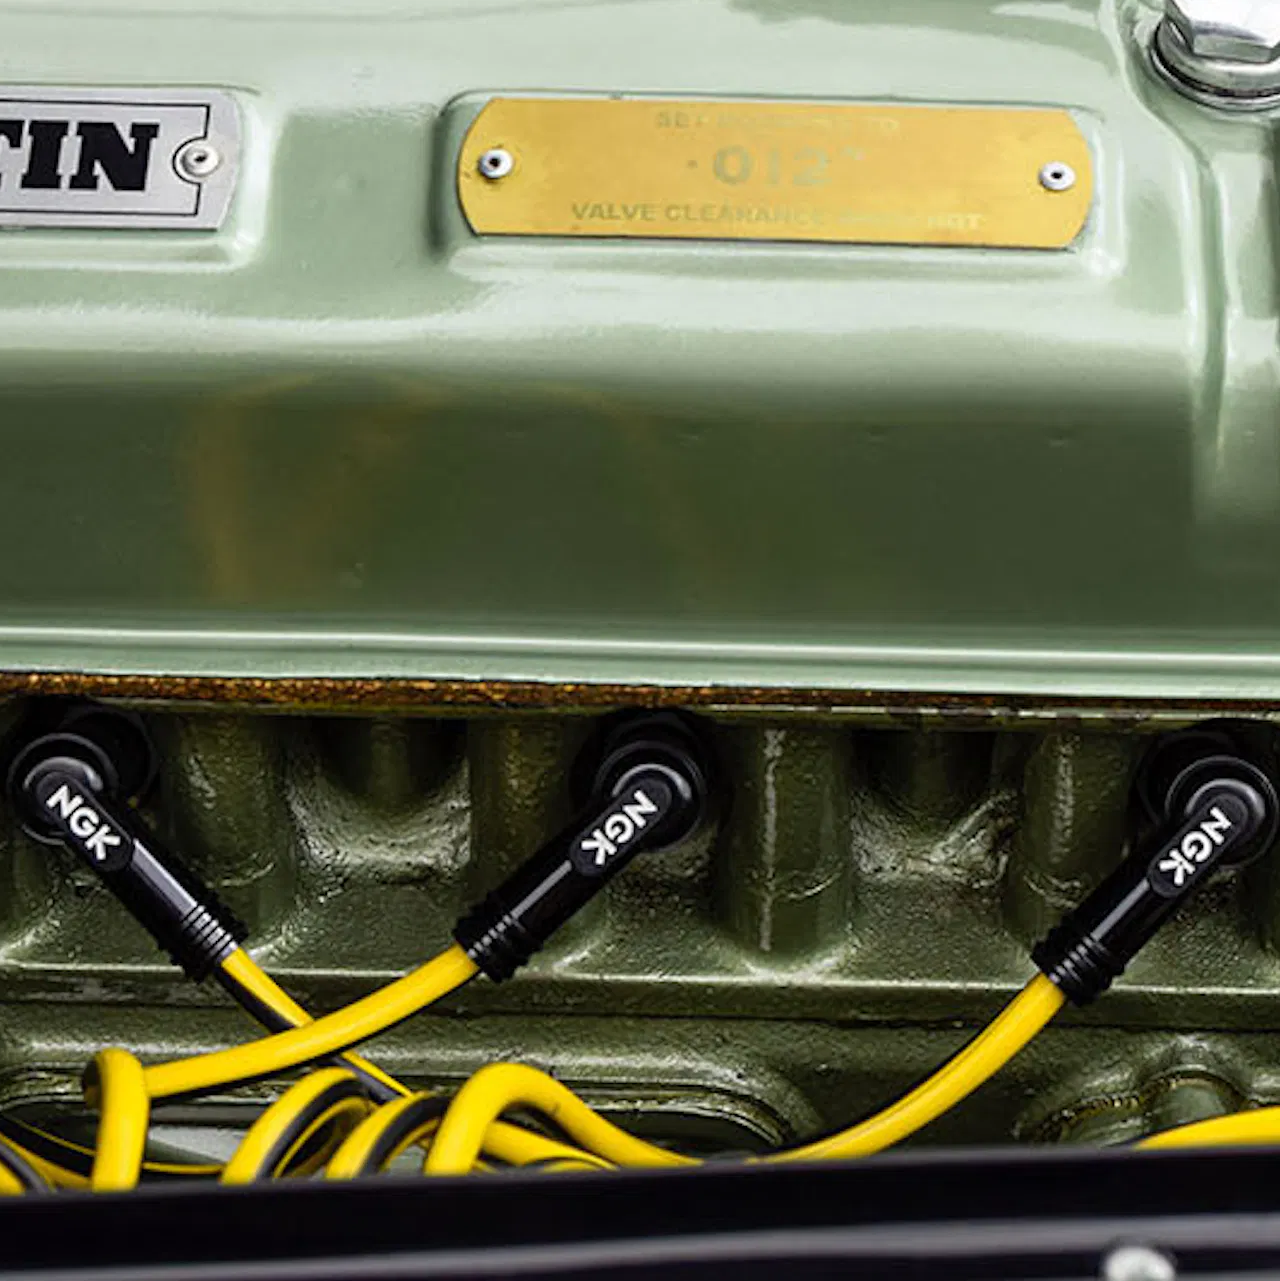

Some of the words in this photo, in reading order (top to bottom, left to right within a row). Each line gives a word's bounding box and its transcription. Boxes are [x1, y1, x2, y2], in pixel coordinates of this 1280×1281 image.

[571, 202, 657, 221] VALVE
[47, 786, 120, 859] NGK
[582, 791, 657, 864] NGK
[1160, 808, 1231, 884] NGK
